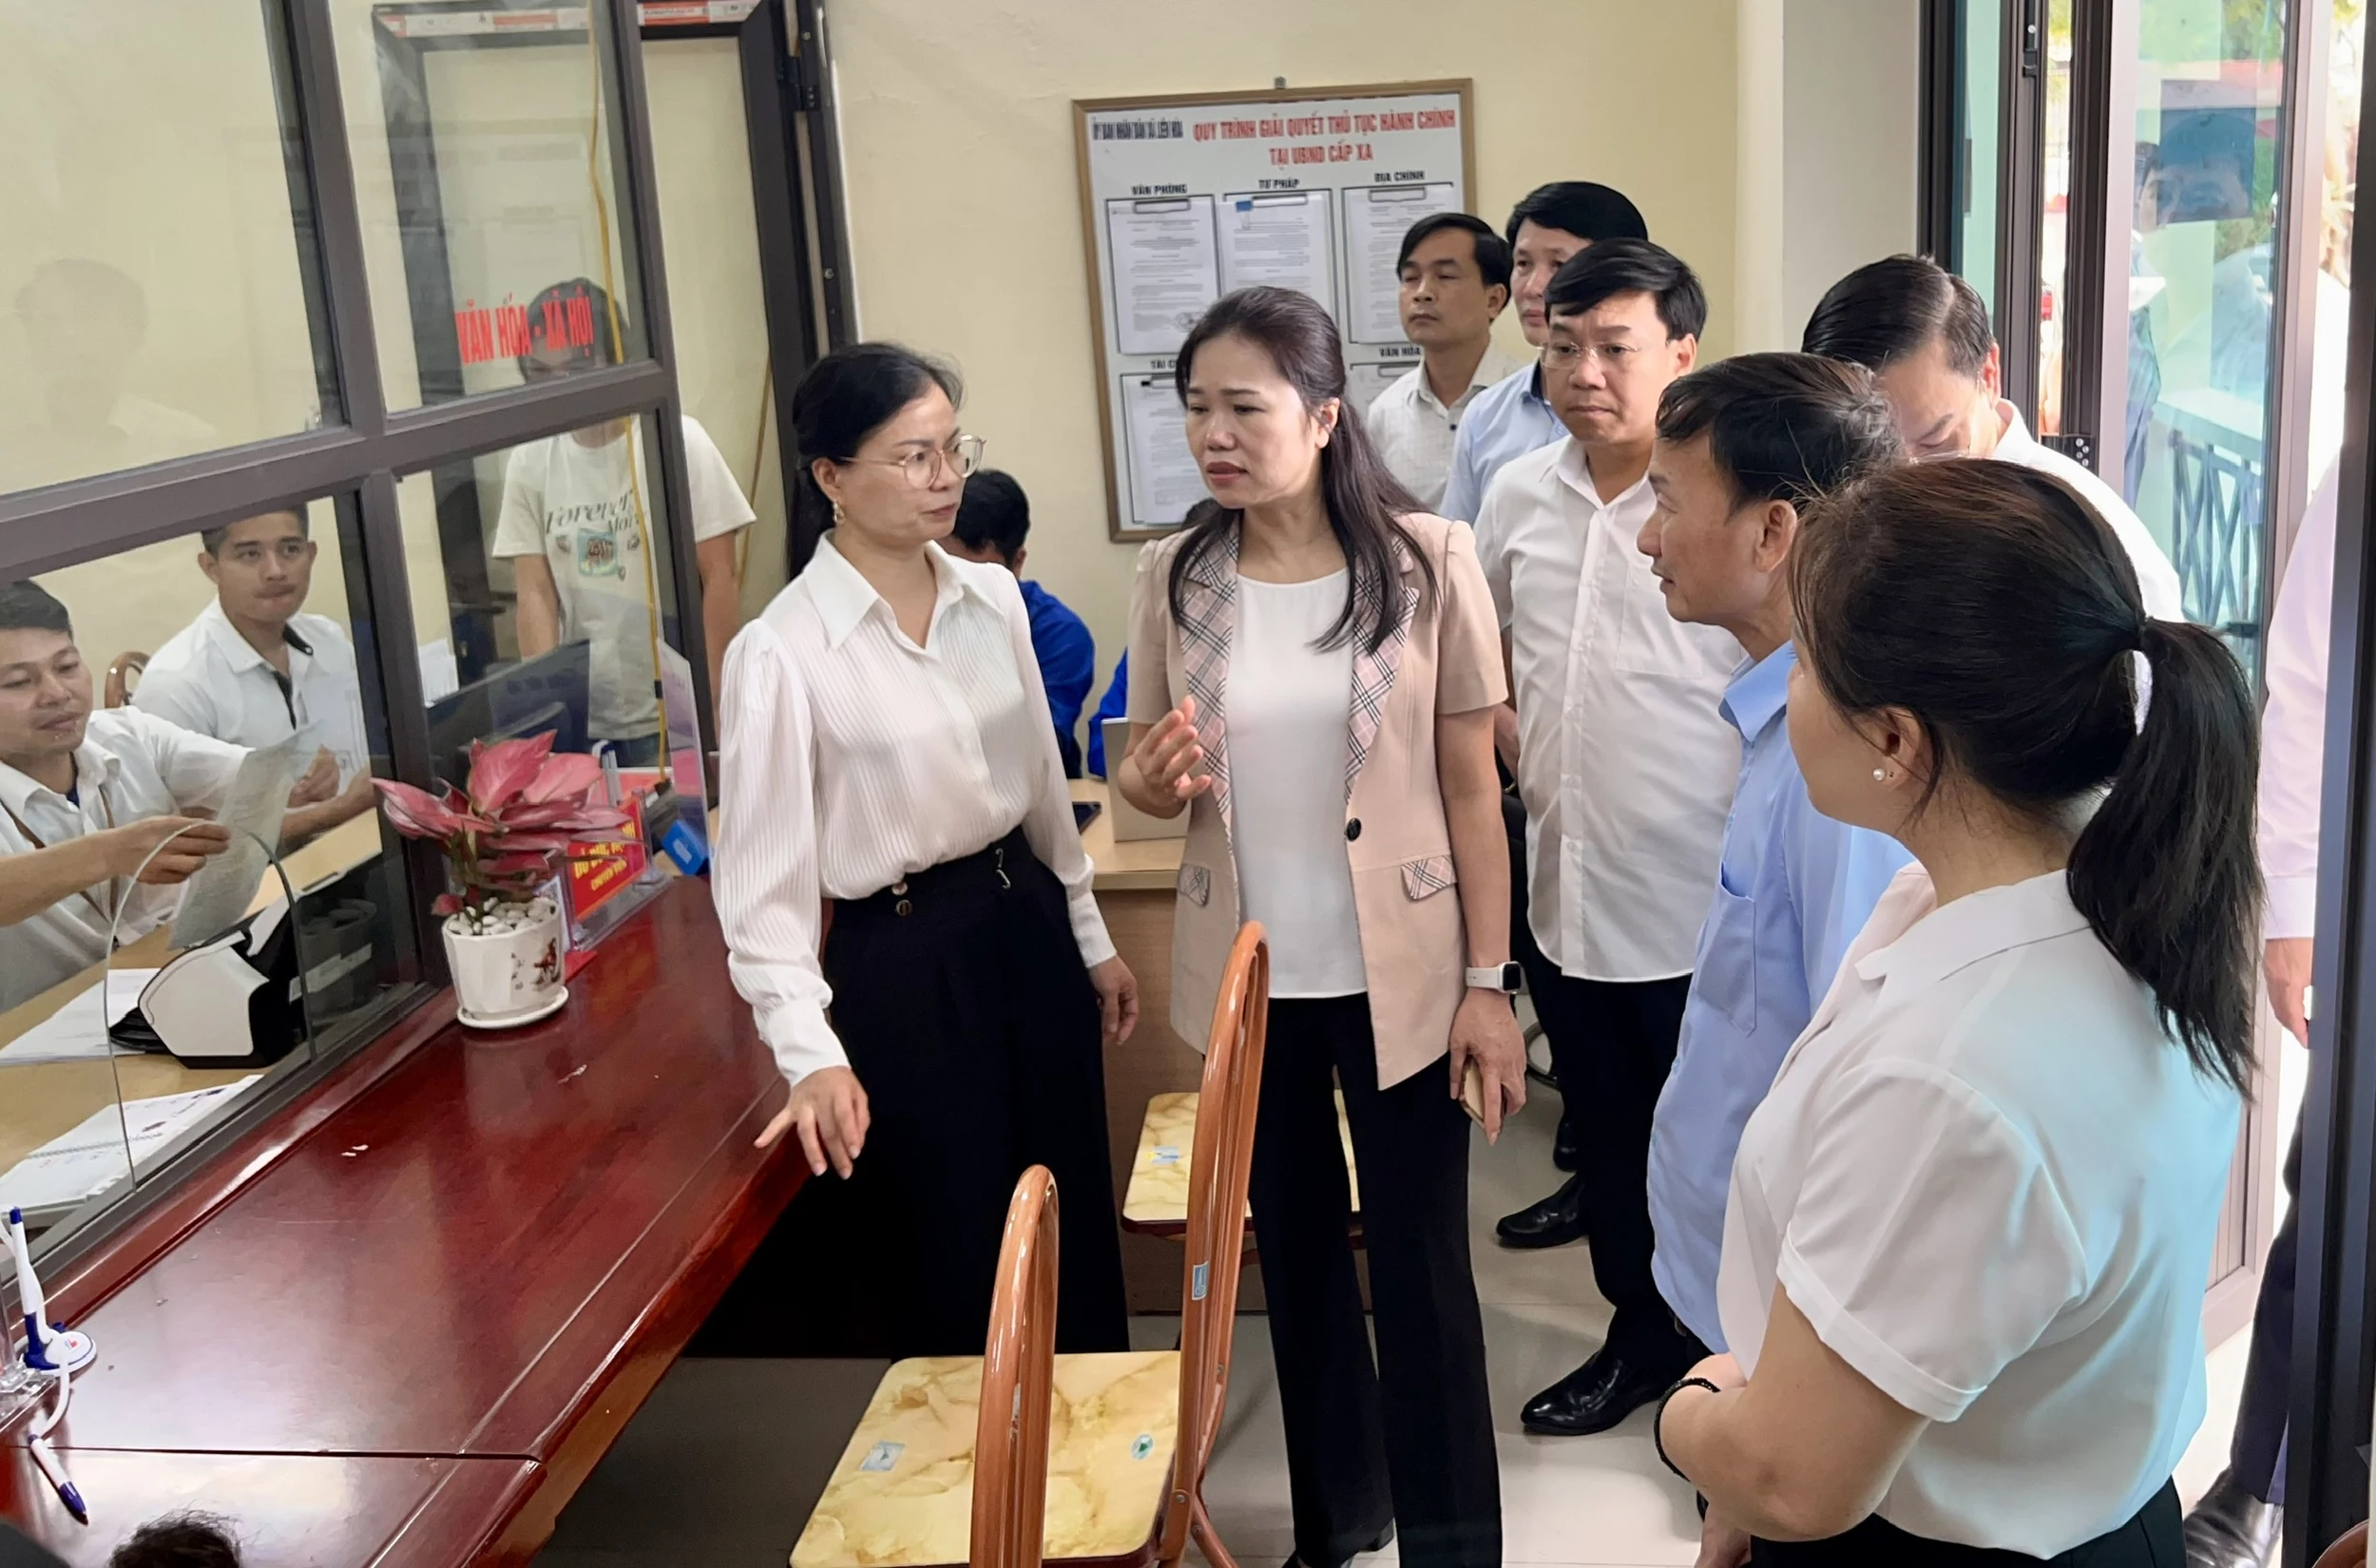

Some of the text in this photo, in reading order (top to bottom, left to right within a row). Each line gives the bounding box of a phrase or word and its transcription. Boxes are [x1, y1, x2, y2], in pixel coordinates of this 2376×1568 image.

[1194, 106, 1455, 143] QUY TRÌNH GIẢI QUYẾT THỦ TỤC HÀNH CHÍNH
[1269, 147, 1289, 171] TẠI
[1292, 145, 1326, 164] UBND
[1329, 139, 1353, 163] CẤP
[454, 298, 495, 366] VĂN
[495, 293, 533, 358] HÓA
[541, 289, 567, 352] XÃ
[565, 284, 595, 357] HỘI
